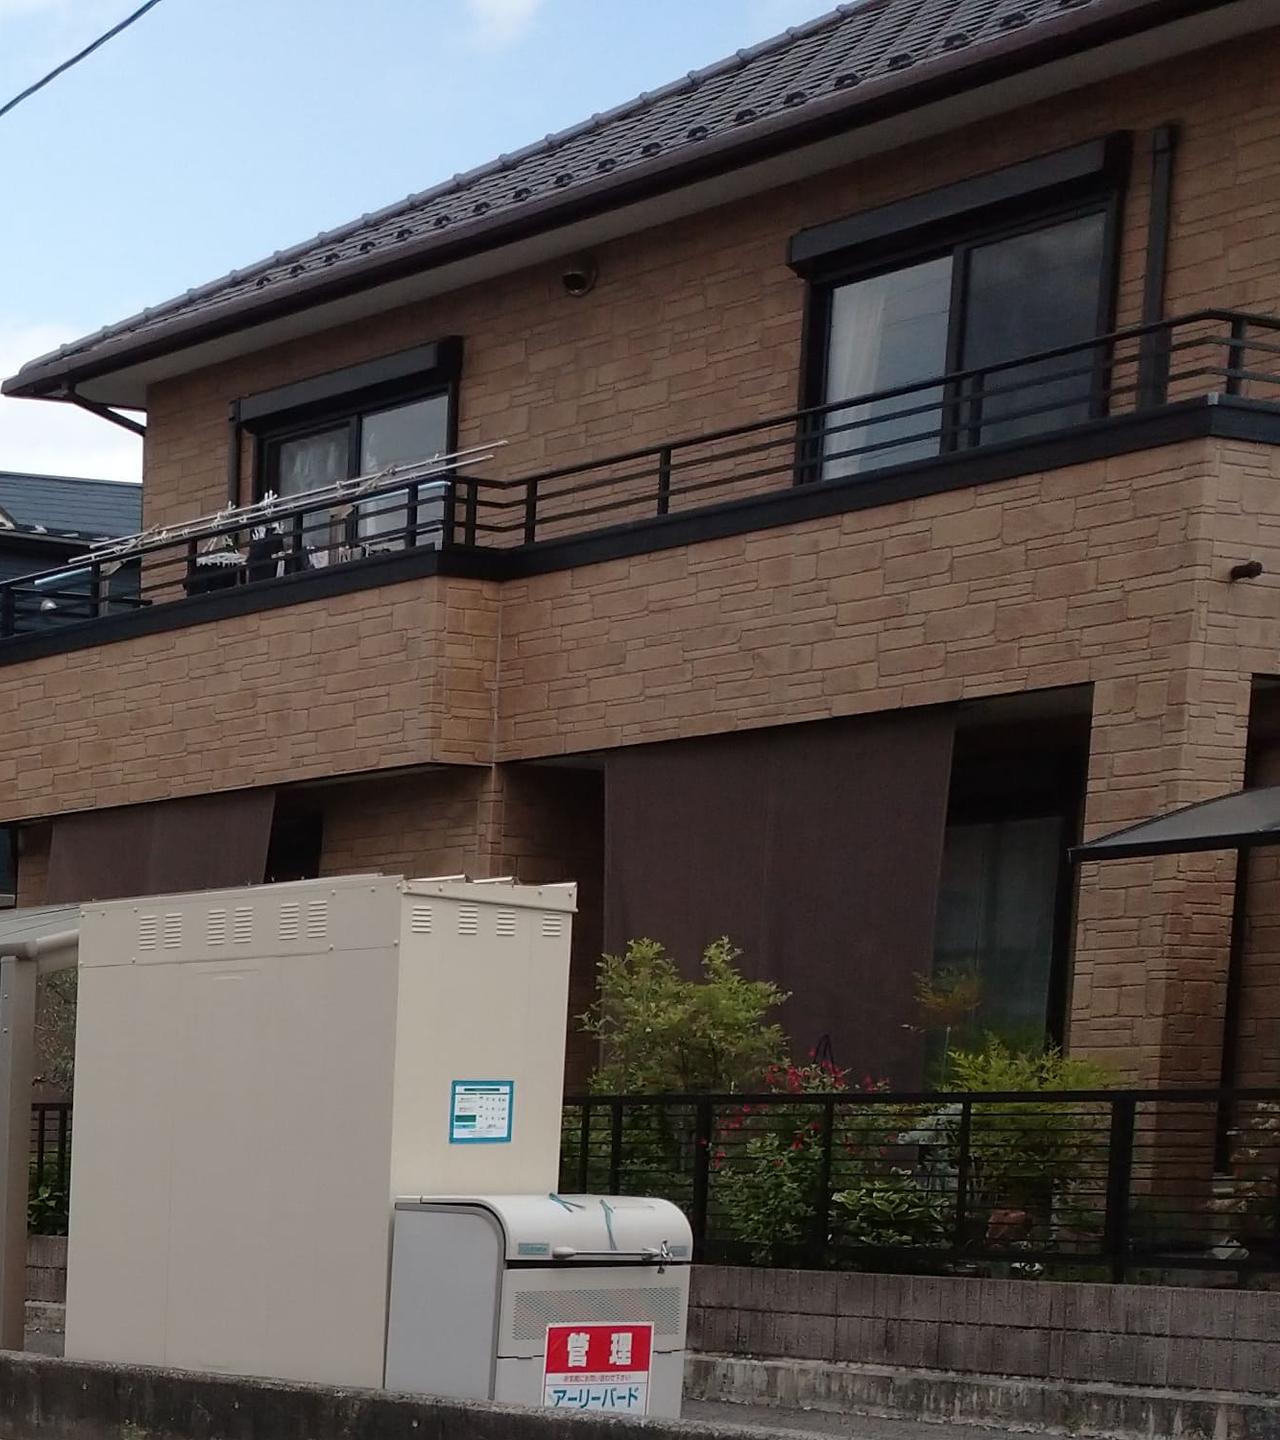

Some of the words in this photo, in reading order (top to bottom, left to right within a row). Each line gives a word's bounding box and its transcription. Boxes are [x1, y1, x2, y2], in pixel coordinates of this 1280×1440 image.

[567, 1332, 633, 1368] 管理
[552, 1387, 640, 1408] アーリーバード
